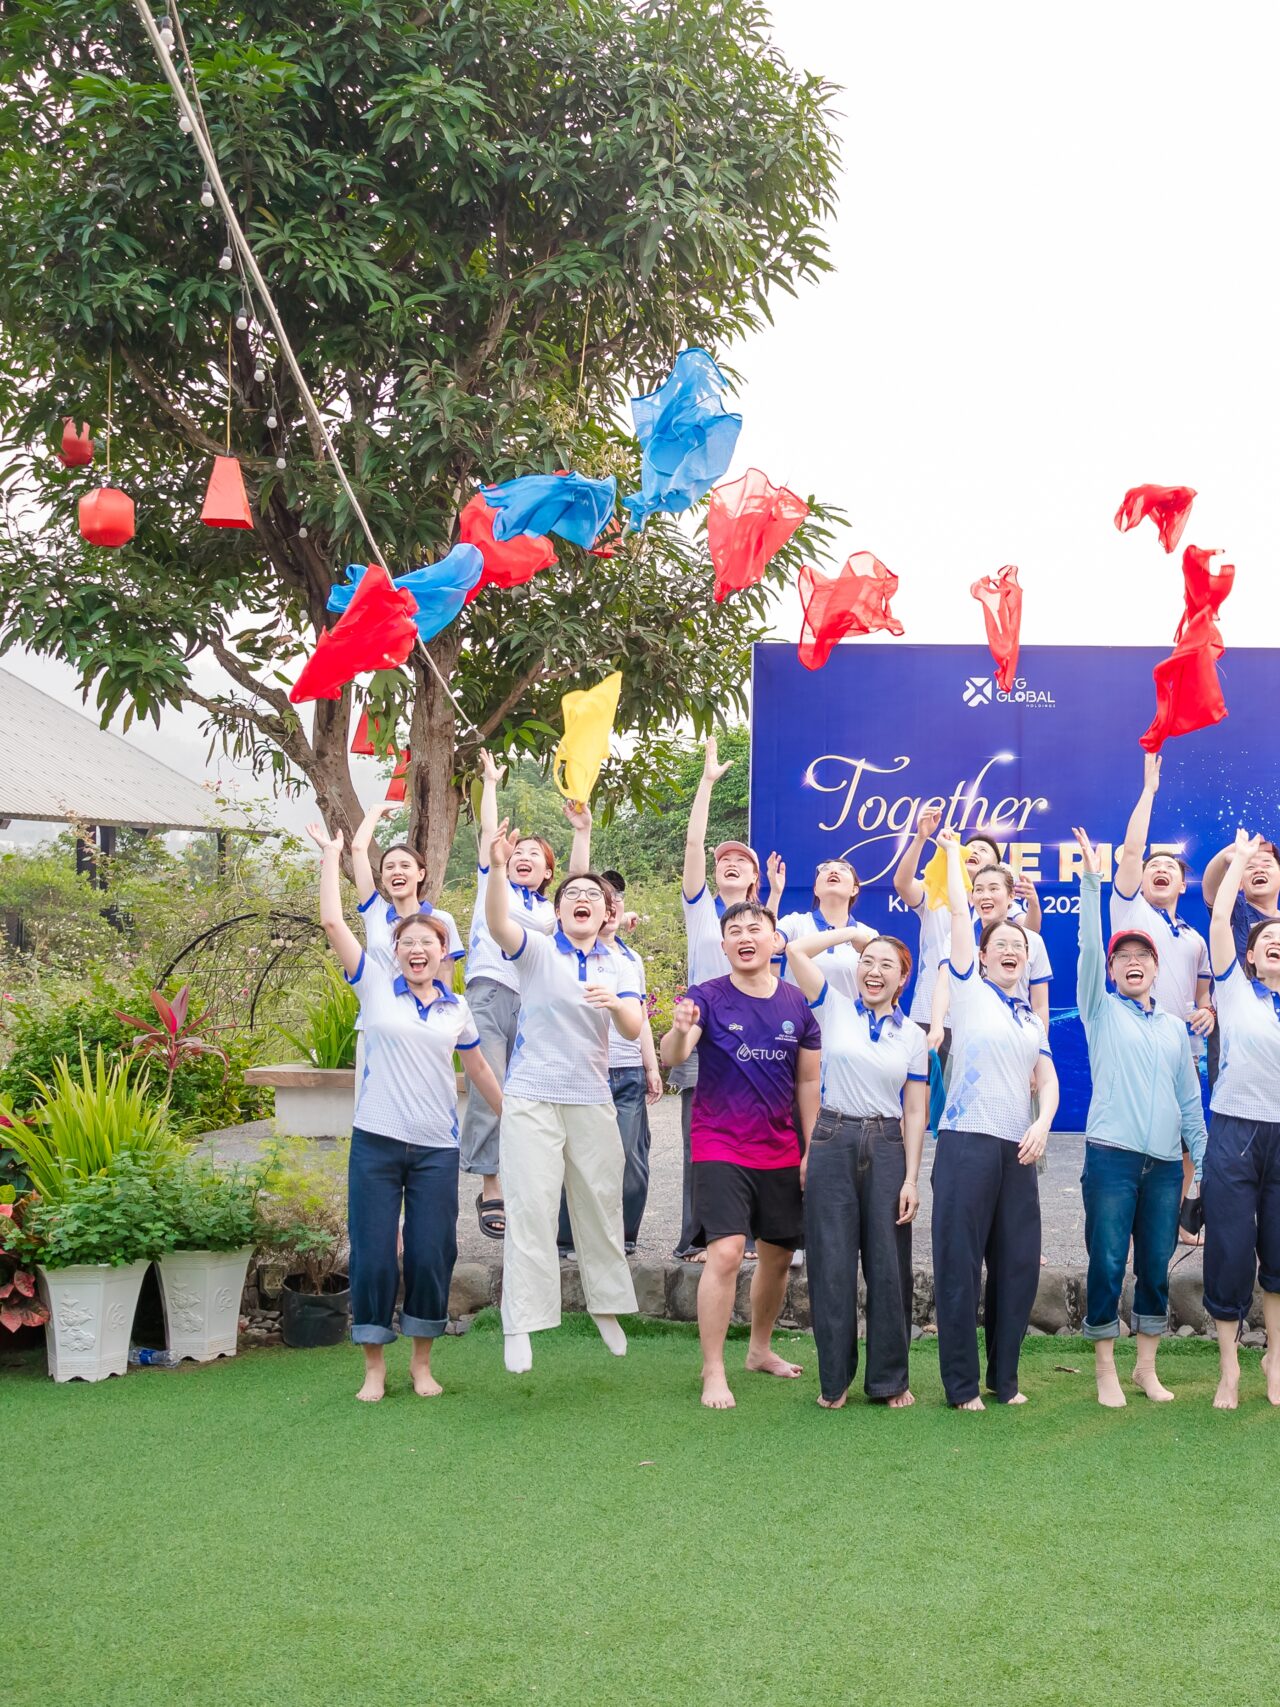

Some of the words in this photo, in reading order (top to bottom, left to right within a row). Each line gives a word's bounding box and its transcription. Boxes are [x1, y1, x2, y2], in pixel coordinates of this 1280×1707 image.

[996, 690, 1056, 702] GLOBAL
[997, 843, 1042, 882] E
[1043, 896, 1081, 914] 202
